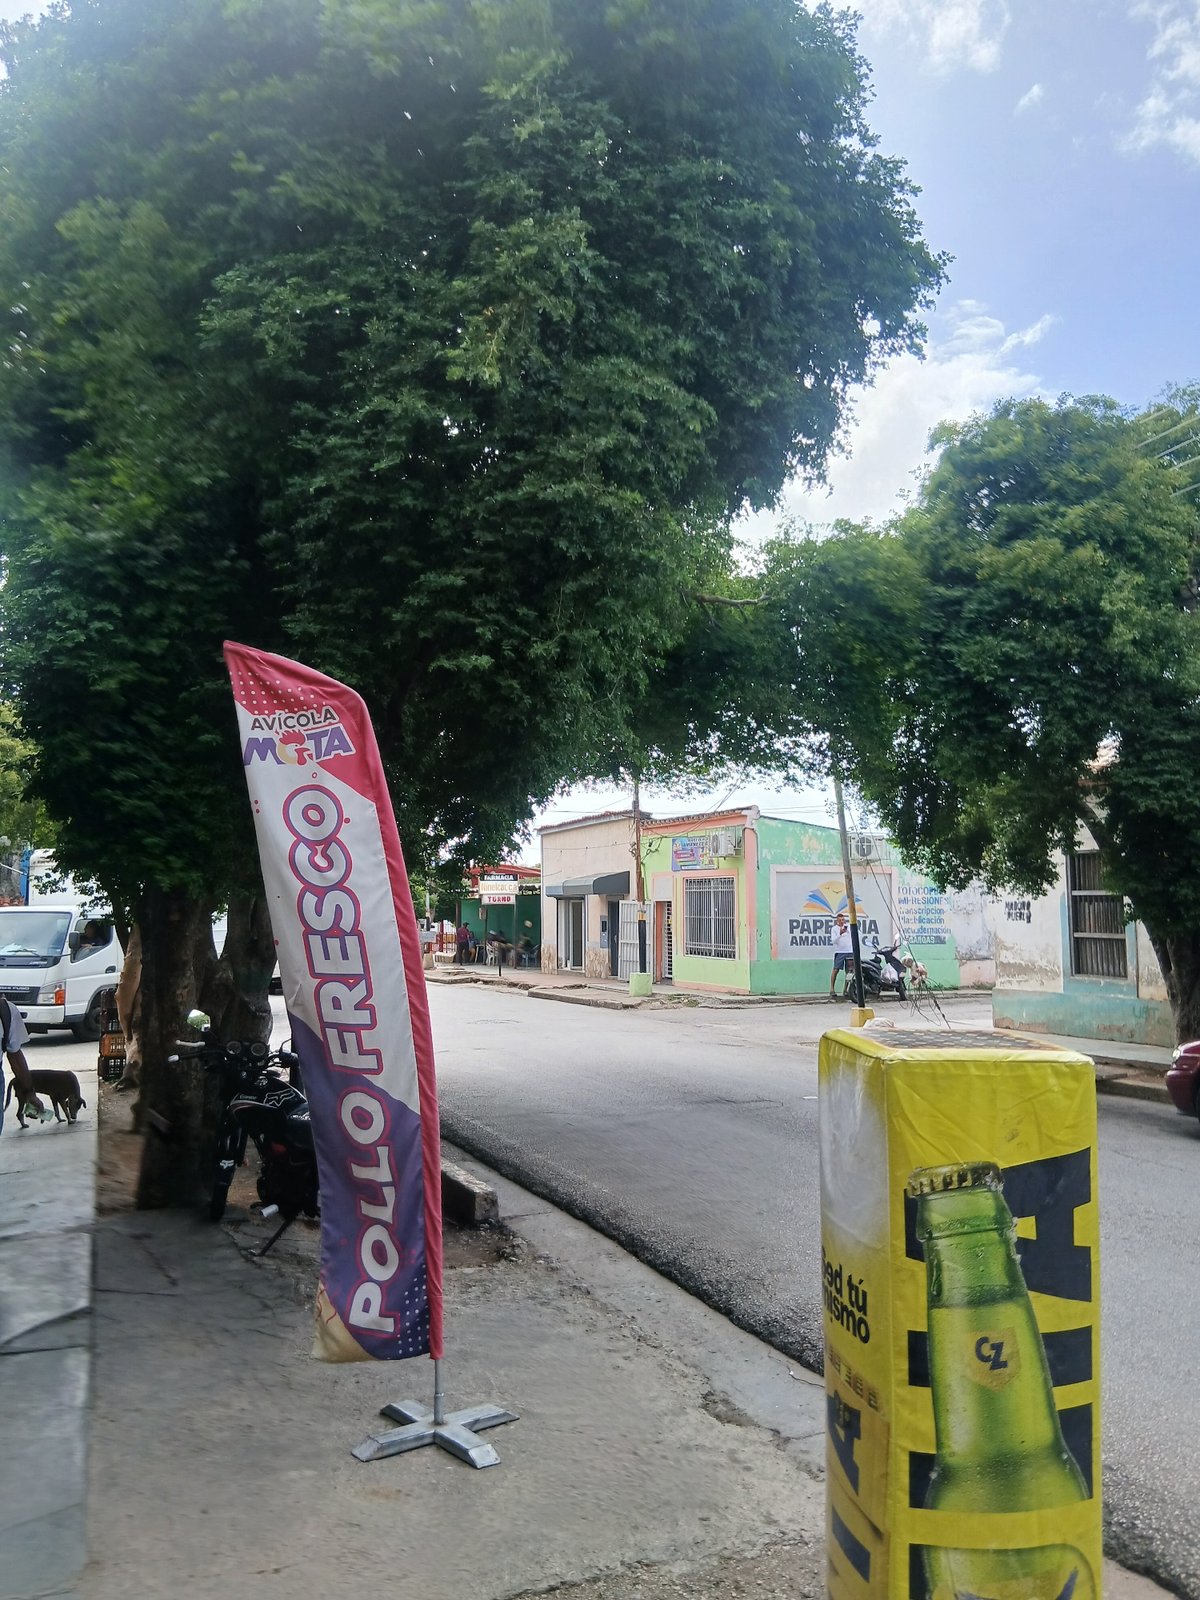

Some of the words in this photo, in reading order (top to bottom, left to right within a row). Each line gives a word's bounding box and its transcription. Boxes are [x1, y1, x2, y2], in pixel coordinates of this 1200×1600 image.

[251, 708, 337, 731] AVÍCOLA
[243, 725, 353, 766] MOTA
[285, 787, 381, 1072] FRESCO
[339, 1089, 401, 1335] POLLO
[847, 1274, 867, 1317] tú
[975, 1336, 1008, 1370] CZ
